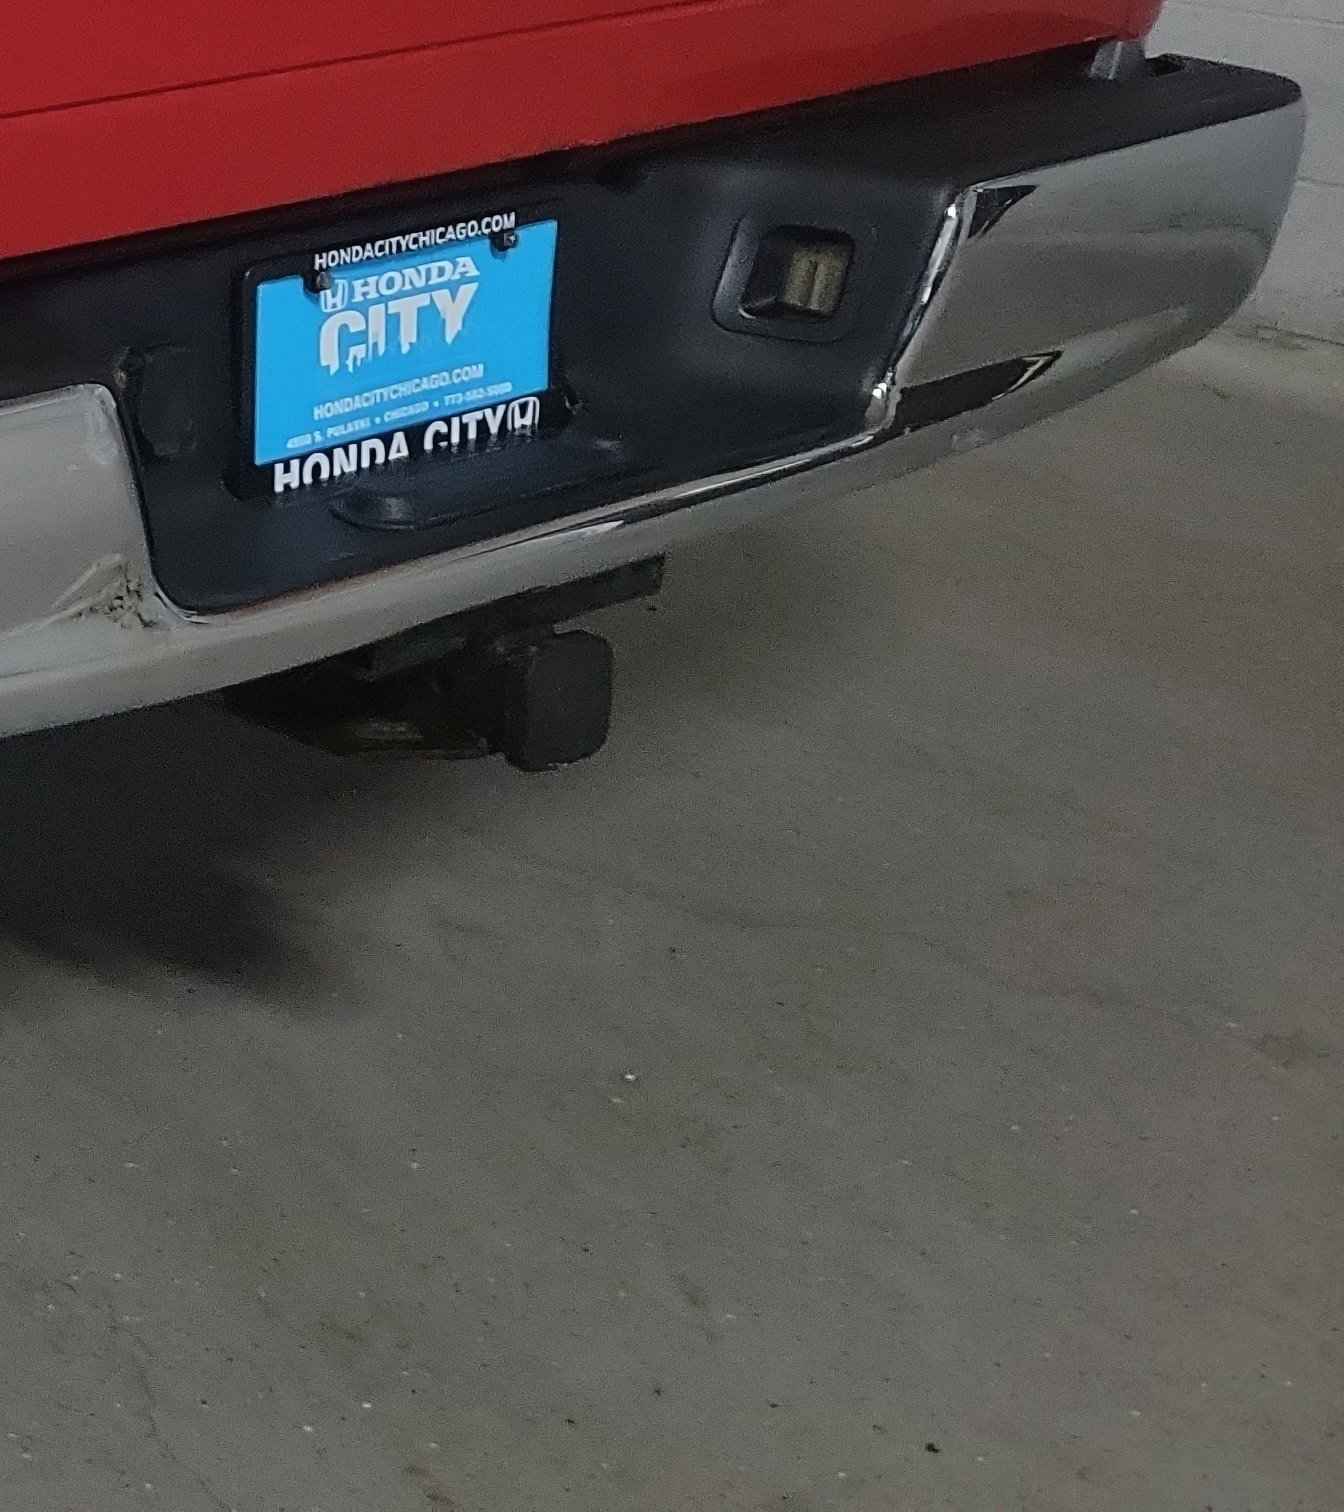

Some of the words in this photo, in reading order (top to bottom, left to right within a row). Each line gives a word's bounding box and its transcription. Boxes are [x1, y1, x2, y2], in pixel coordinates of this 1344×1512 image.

[314, 212, 516, 272] HONDACITYCHICAGO.COM
[350, 256, 481, 303] HONDA
[319, 282, 480, 377] CITY
[313, 363, 485, 421] HONDACITYCHICAGO.COM
[274, 431, 410, 494] HONDA
[424, 404, 506, 455] CITY
